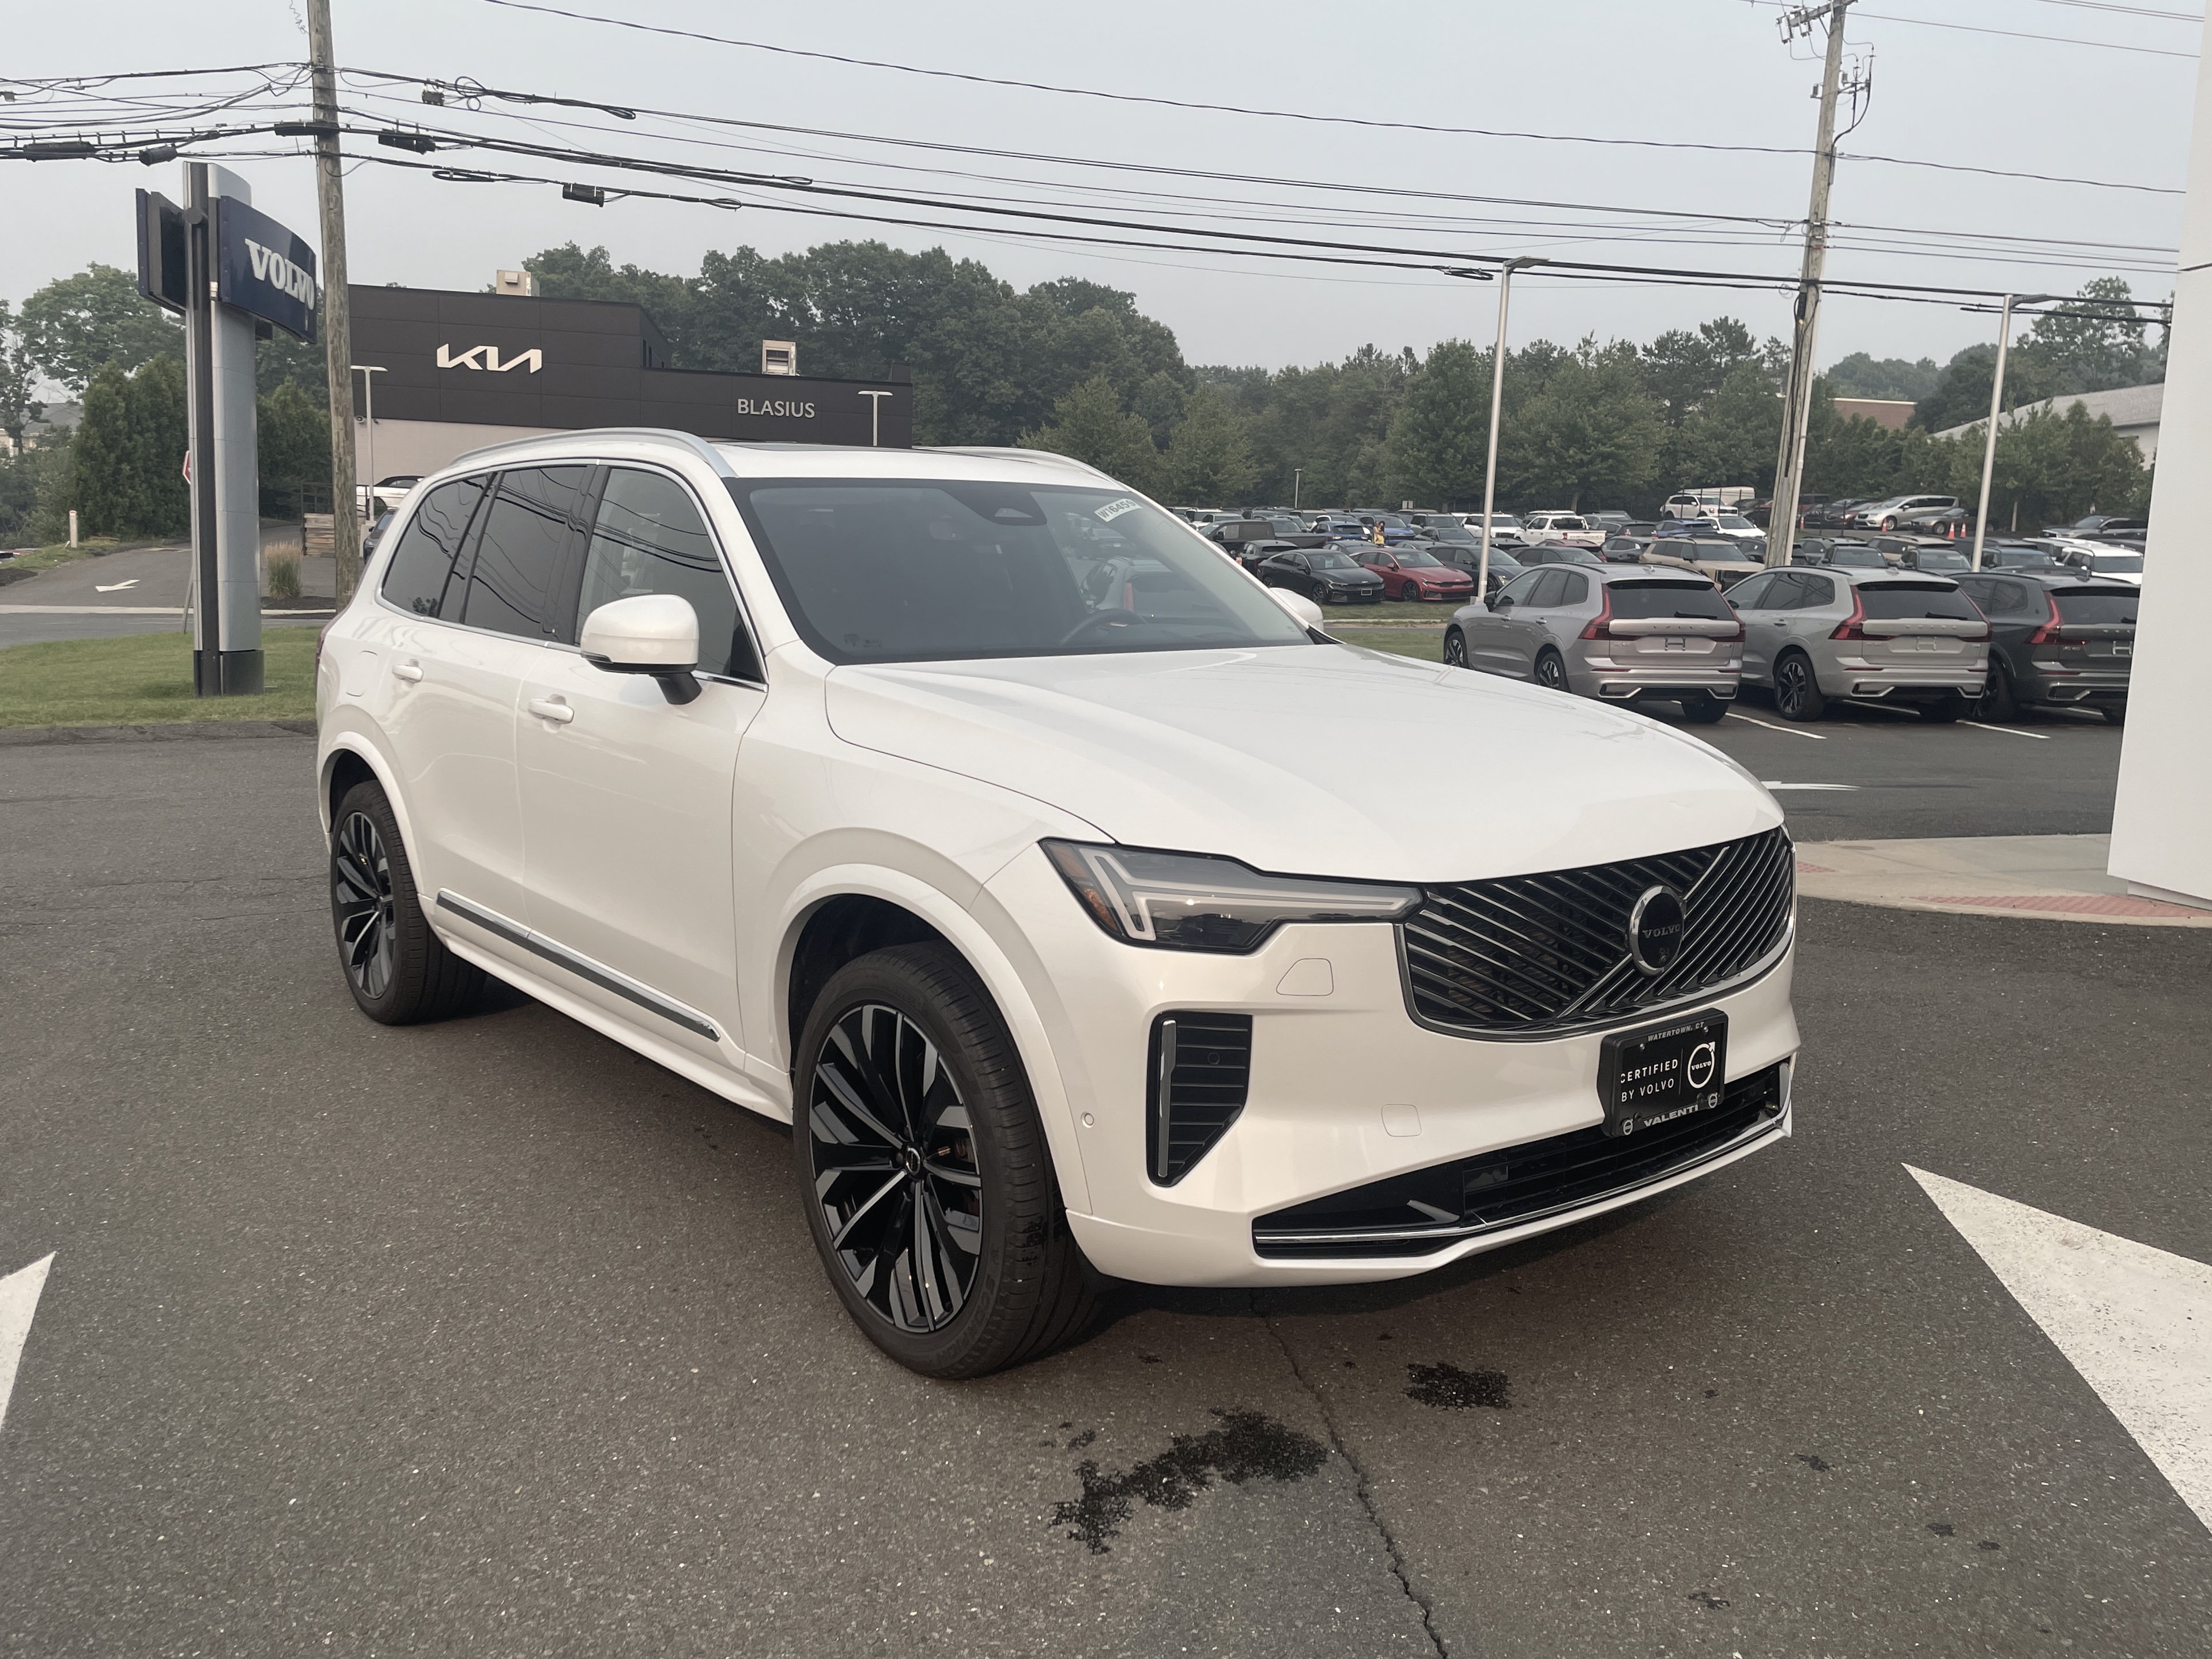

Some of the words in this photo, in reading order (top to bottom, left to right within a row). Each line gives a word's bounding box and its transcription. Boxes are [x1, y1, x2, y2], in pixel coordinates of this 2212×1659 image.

[244, 238, 315, 310] VOLVO
[437, 343, 542, 374] KIA
[737, 398, 816, 418] BLASIUS
[1098, 500, 1136, 518] W16459
[1643, 924, 1681, 938] VOLVO
[1621, 1059, 1678, 1083] CERTIFIED
[1691, 1061, 1712, 1070] VOLVO
[1621, 1089, 1635, 1102] BY
[1640, 1078, 1674, 1096] VOLVO
[1644, 1104, 1698, 1126] VALENTI
